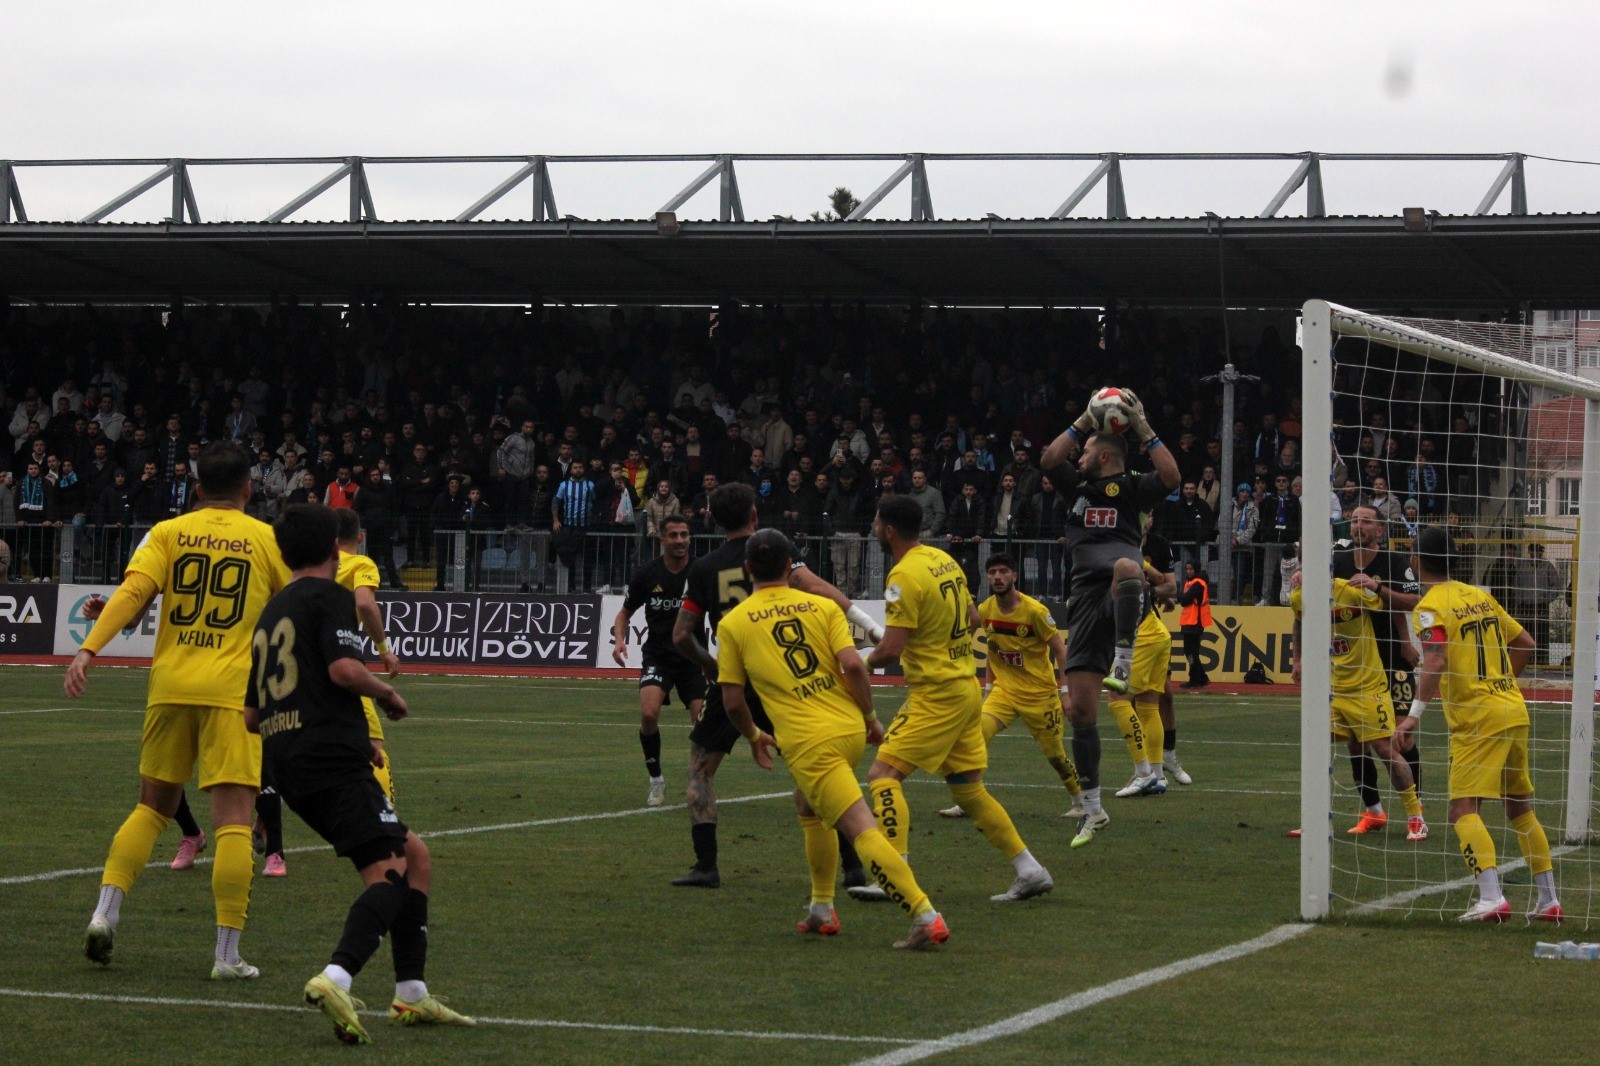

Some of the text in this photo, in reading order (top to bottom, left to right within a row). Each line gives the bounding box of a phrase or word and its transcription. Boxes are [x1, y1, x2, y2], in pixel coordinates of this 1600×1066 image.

[177, 532, 253, 555] turknet
[170, 553, 251, 630] 99
[482, 602, 594, 634] ZERDE
[748, 601, 818, 623] turknet
[772, 617, 819, 679] 8
[1460, 616, 1509, 681] 77
[252, 617, 299, 710] 23
[792, 673, 837, 700] TAYFUN
[1392, 683, 1413, 701] 39
[1376, 704, 1389, 724] 5
